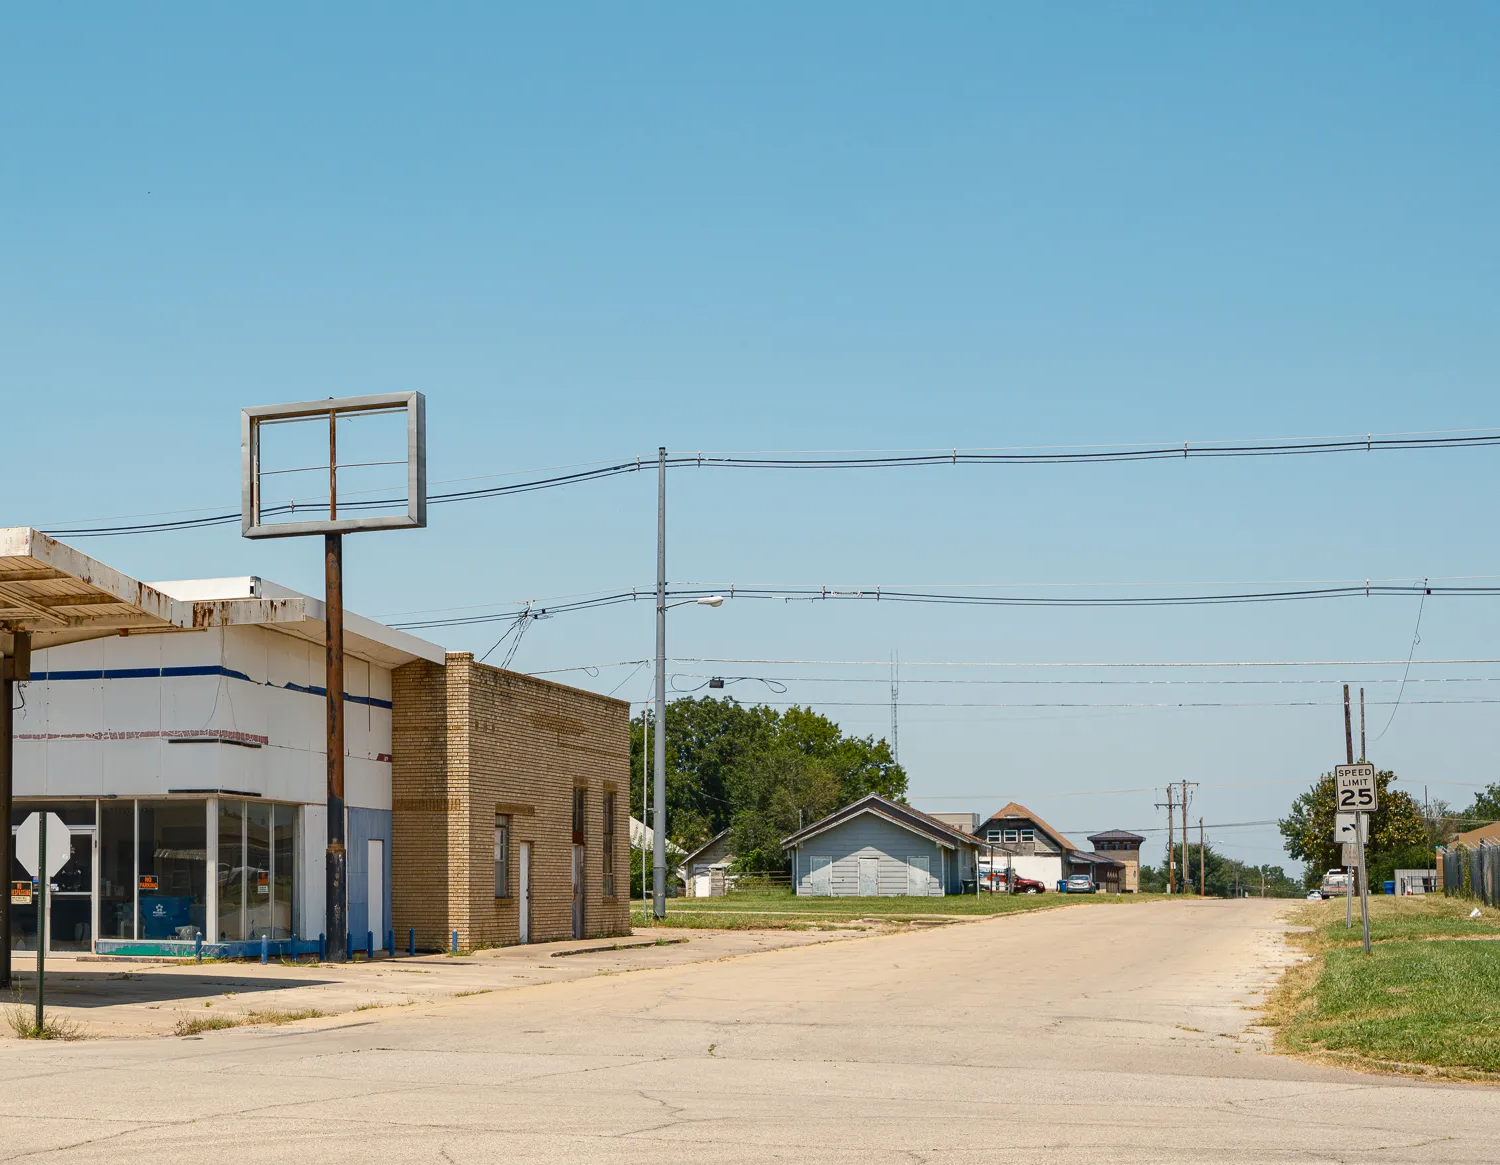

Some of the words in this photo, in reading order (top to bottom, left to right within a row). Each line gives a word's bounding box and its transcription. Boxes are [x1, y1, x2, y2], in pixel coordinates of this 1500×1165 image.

[1338, 768, 1371, 777] SPEED
[1342, 778, 1368, 787] LIMIT
[1340, 788, 1373, 806] 25
